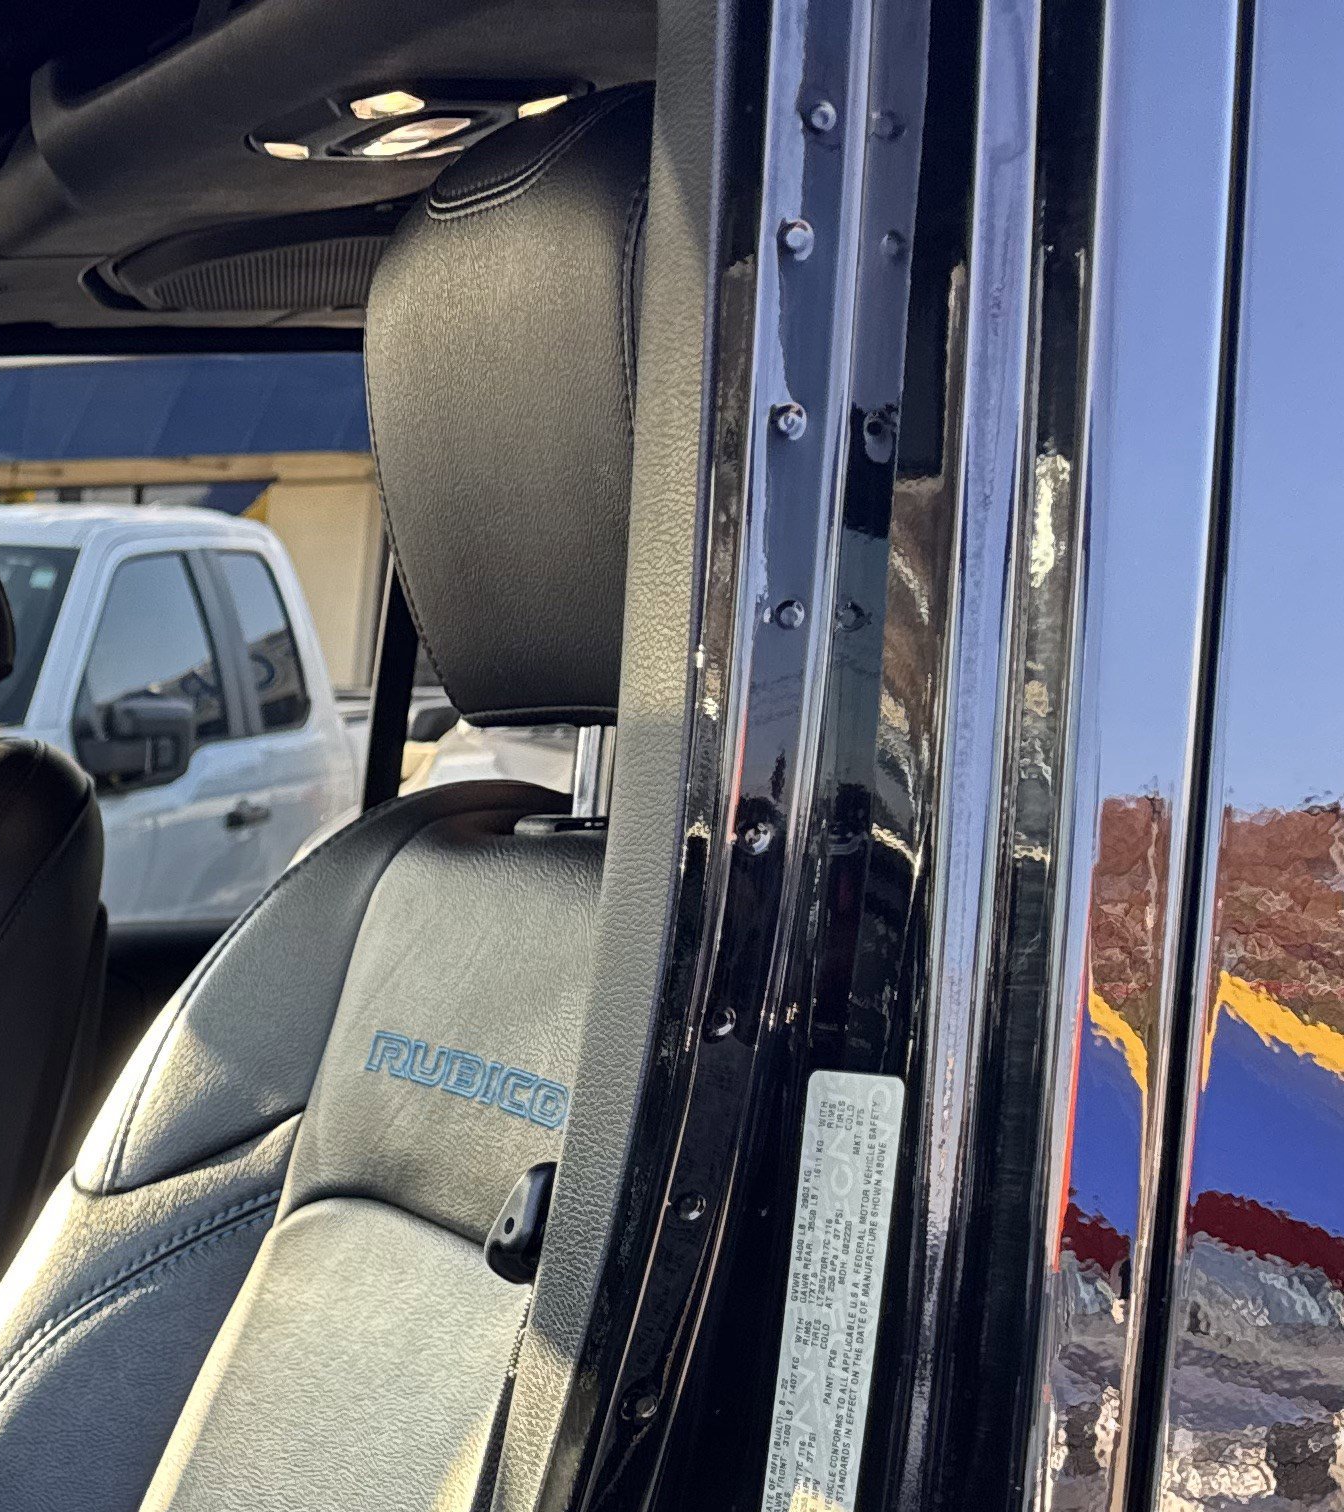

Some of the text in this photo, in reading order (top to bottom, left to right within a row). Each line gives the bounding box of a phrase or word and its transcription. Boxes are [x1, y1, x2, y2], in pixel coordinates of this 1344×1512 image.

[817, 1100, 828, 1127] WITH
[826, 1102, 837, 1129] RIMS
[835, 1099, 846, 1129] TIRES
[844, 1103, 855, 1131] COLD
[867, 1100, 881, 1140] SAFETY
[802, 1169, 812, 1182] KG
[862, 1143, 876, 1185] VEHICLE
[857, 1188, 870, 1225] MOTOR
[869, 1178, 882, 1217] SHOWN
[798, 1272, 809, 1304] GAWR
[809, 1193, 818, 1206] LB
[815, 1139, 824, 1153] KG
[834, 1208, 844, 1225] PSI
[832, 1227, 841, 1240] 37
[852, 1227, 866, 1274] FEDERAL
[860, 1219, 879, 1298] MANUFACTURE
[824, 1295, 833, 1309] AT
[858, 1300, 869, 1315] OF
[794, 1316, 804, 1344] WITH
[802, 1319, 812, 1346] RIMS
[810, 1318, 821, 1347] TIRES
[819, 1323, 830, 1350] COLD
[840, 1310, 856, 1373] APPLICABLE
[855, 1316, 866, 1344] DATE
[791, 1355, 800, 1370] KG
[852, 1346, 863, 1367] THE
[788, 1371, 798, 1395] 1407
[837, 1375, 848, 1395] ALL
[850, 1369, 860, 1385] ON
[836, 1396, 845, 1409] TO
[844, 1387, 858, 1425] EFFECT
[807, 1431, 816, 1448] PSI
[828, 1412, 843, 1469] CONFORMS
[843, 1427, 853, 1439] IN
[805, 1450, 814, 1463] 37
[767, 1477, 776, 1491] OF
[835, 1440, 851, 1503] STANDARDS
[823, 1469, 836, 1511] VEHICLE
